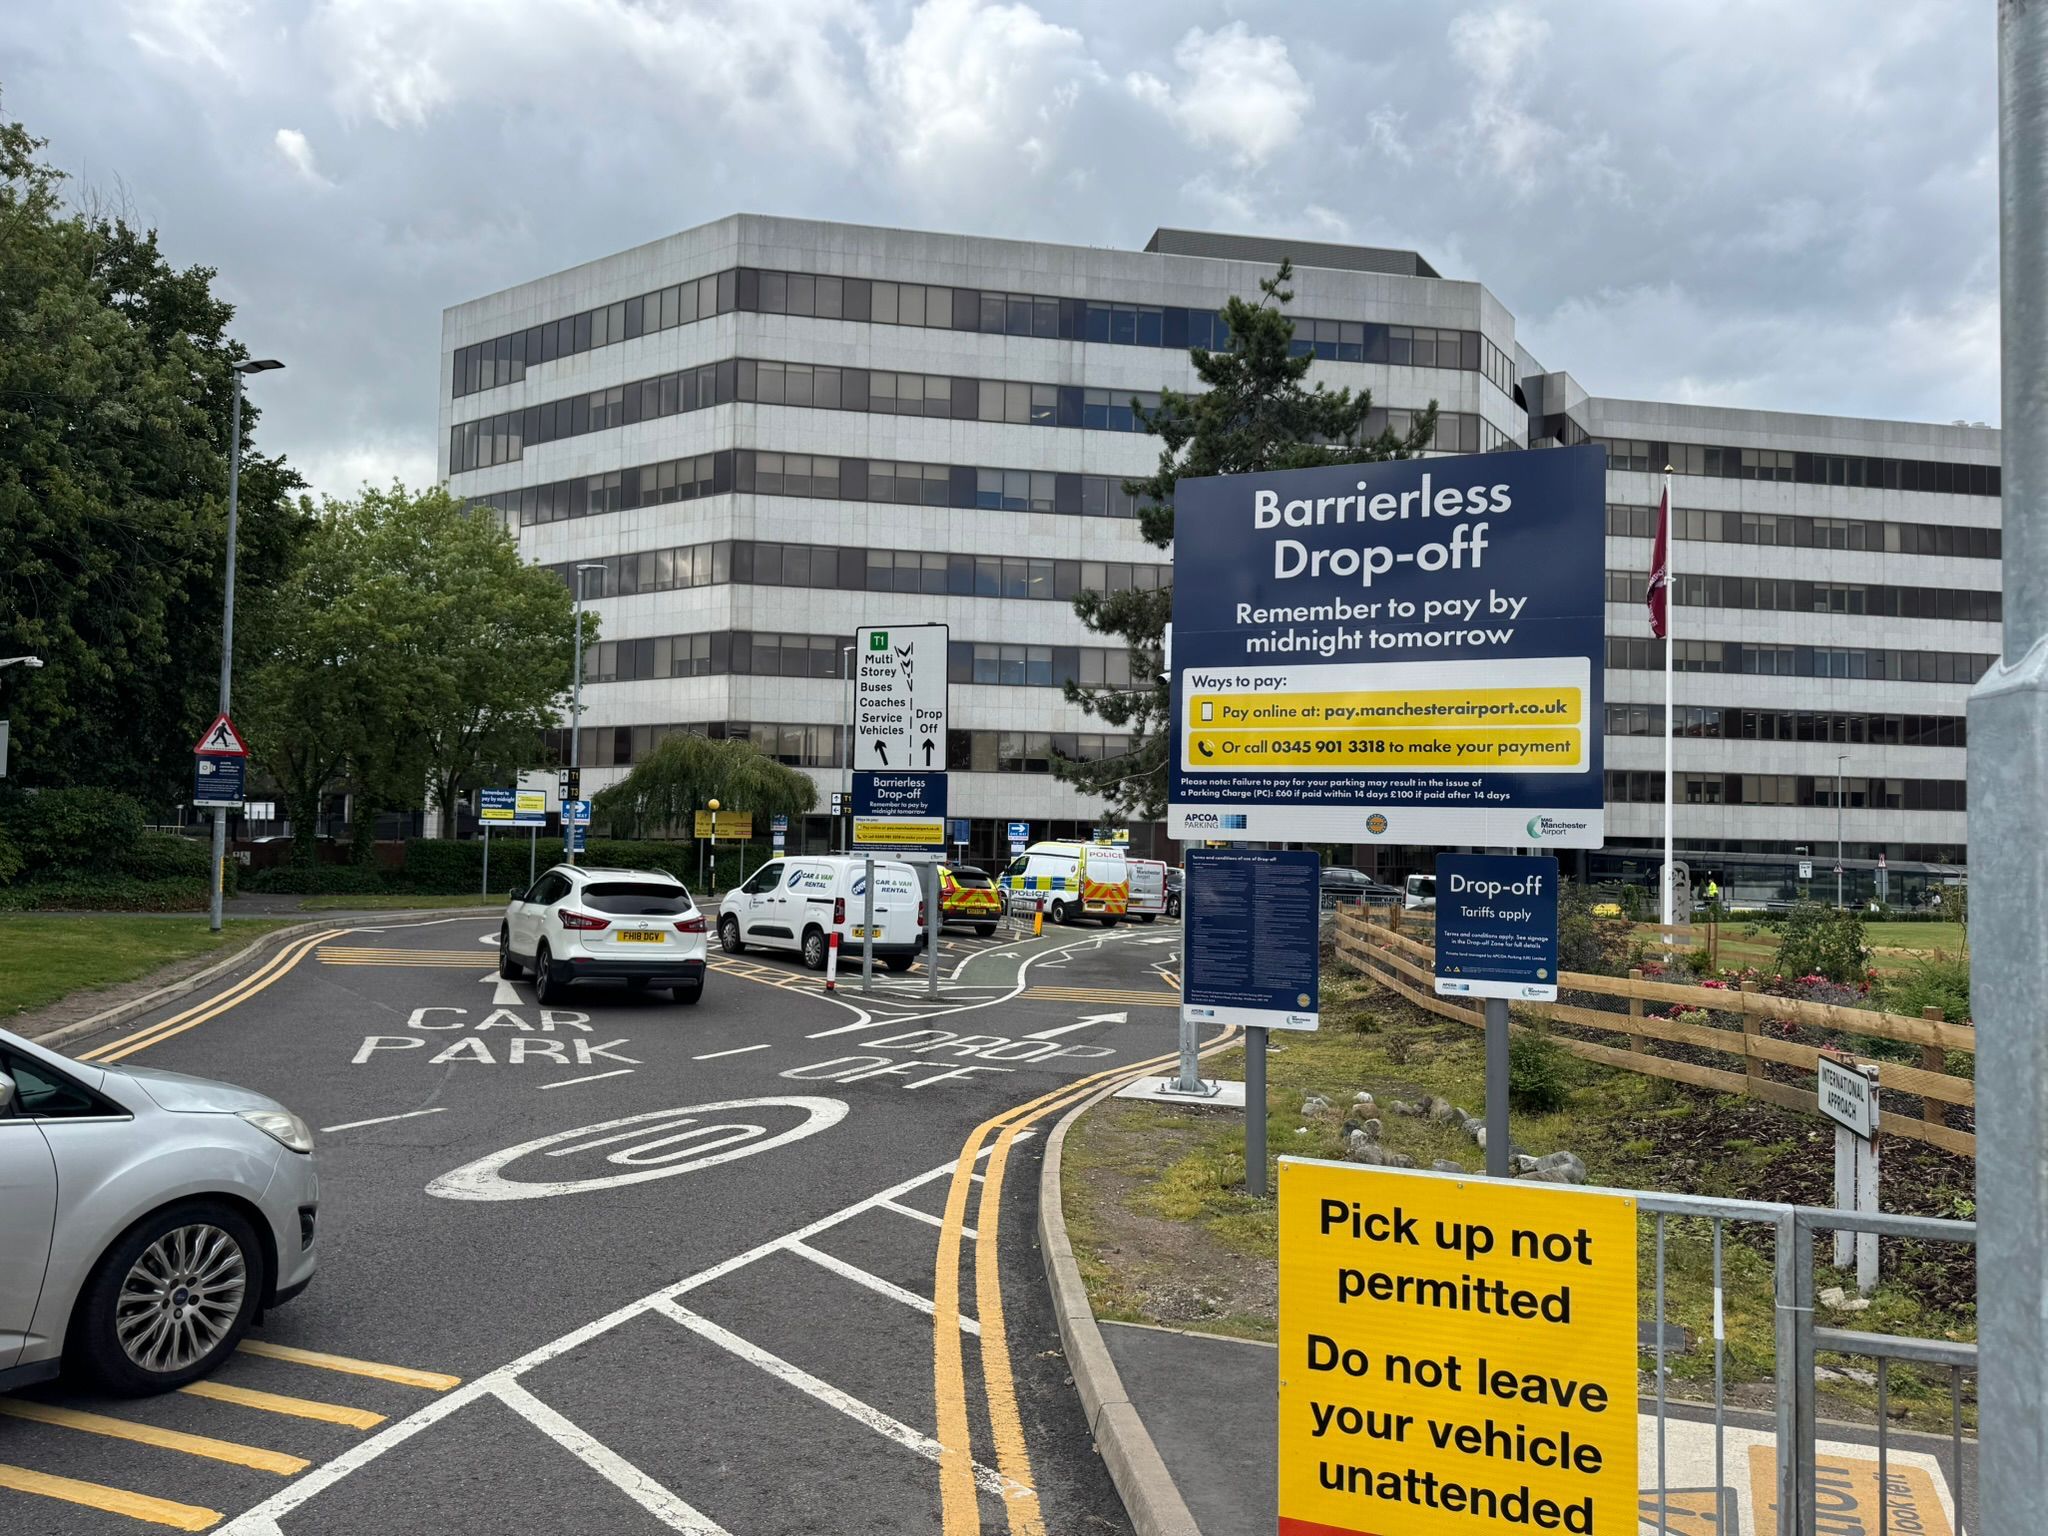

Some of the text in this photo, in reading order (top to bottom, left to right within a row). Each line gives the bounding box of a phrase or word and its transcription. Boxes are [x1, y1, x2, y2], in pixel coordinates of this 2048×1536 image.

[1253, 473, 1512, 530] Barrierless
[1274, 522, 1489, 587] Drop-off
[1236, 588, 1528, 625] Remember to pay by
[874, 636, 884, 646] T1
[1246, 626, 1515, 657] midnight tomorrow
[865, 654, 893, 664] Multi
[860, 666, 897, 678] Storey
[860, 682, 893, 692] Buses
[1192, 675, 1288, 691] Ways to pay:
[860, 697, 906, 708] Coaches
[916, 708, 943, 720] Drop
[1222, 699, 1568, 721] Pay online at: pay.manchesterairport.co.uk
[861, 713, 903, 723] Service
[859, 725, 904, 735] Vehicles
[919, 723, 939, 734] Off
[1222, 739, 1571, 756] Or call 0345 901 3318 to make your payment
[571, 771, 579, 780] T1
[873, 776, 926, 788] Barrierless
[1181, 778, 1208, 786] Please
[1209, 778, 1230, 786] note:
[1232, 778, 1261, 786] Failure
[1273, 780, 1291, 788] pay
[1292, 778, 1305, 786] for
[1307, 780, 1328, 788] your
[1330, 778, 1365, 788] parking
[1367, 780, 1388, 788] may
[1390, 779, 1416, 787] result
[1418, 779, 1427, 787] in
[1429, 778, 1443, 787] the
[1445, 779, 1470, 787] issue
[1472, 779, 1482, 787] of
[570, 788, 579, 797] T3
[877, 788, 922, 802] Drop-off
[1188, 789, 1220, 798] Parking
[1221, 789, 1251, 799] Charge
[1253, 789, 1274, 798] (PC):
[1301, 790, 1322, 799] paid
[1324, 790, 1351, 798] within
[1354, 790, 1364, 798] 14
[1366, 790, 1388, 800] days
[1390, 791, 1413, 799] £100
[1415, 791, 1422, 799] if
[1424, 791, 1445, 800] paid
[1447, 791, 1470, 799] after
[1474, 791, 1484, 799] 14
[1487, 791, 1511, 801] days
[1185, 813, 1219, 822] APCOA
[1184, 821, 1219, 829] PARKING
[1540, 821, 1587, 829] Manchester
[1540, 828, 1567, 836] Airport
[1089, 851, 1123, 859] POLICE
[1450, 874, 1542, 900] Drop-off
[1011, 890, 1050, 898] POLICE
[1460, 906, 1532, 922] Tariffs apply
[623, 931, 660, 941] FH18 DGV
[1527, 935, 1548, 943] signage
[407, 1007, 594, 1032] CAR
[351, 1036, 644, 1064] PARK
[858, 1030, 1116, 1063] DROP
[778, 1056, 1016, 1089] OFF
[1822, 1066, 1864, 1103] INTERNATIONAL
[1828, 1090, 1857, 1121] APPROACH
[1320, 1198, 1593, 1266] Pick up not
[1338, 1268, 1571, 1324] permitted
[1307, 1333, 1609, 1413] Do not leave
[1310, 1401, 1603, 1475] your vehicle
[1319, 1461, 1594, 1536] unattended
